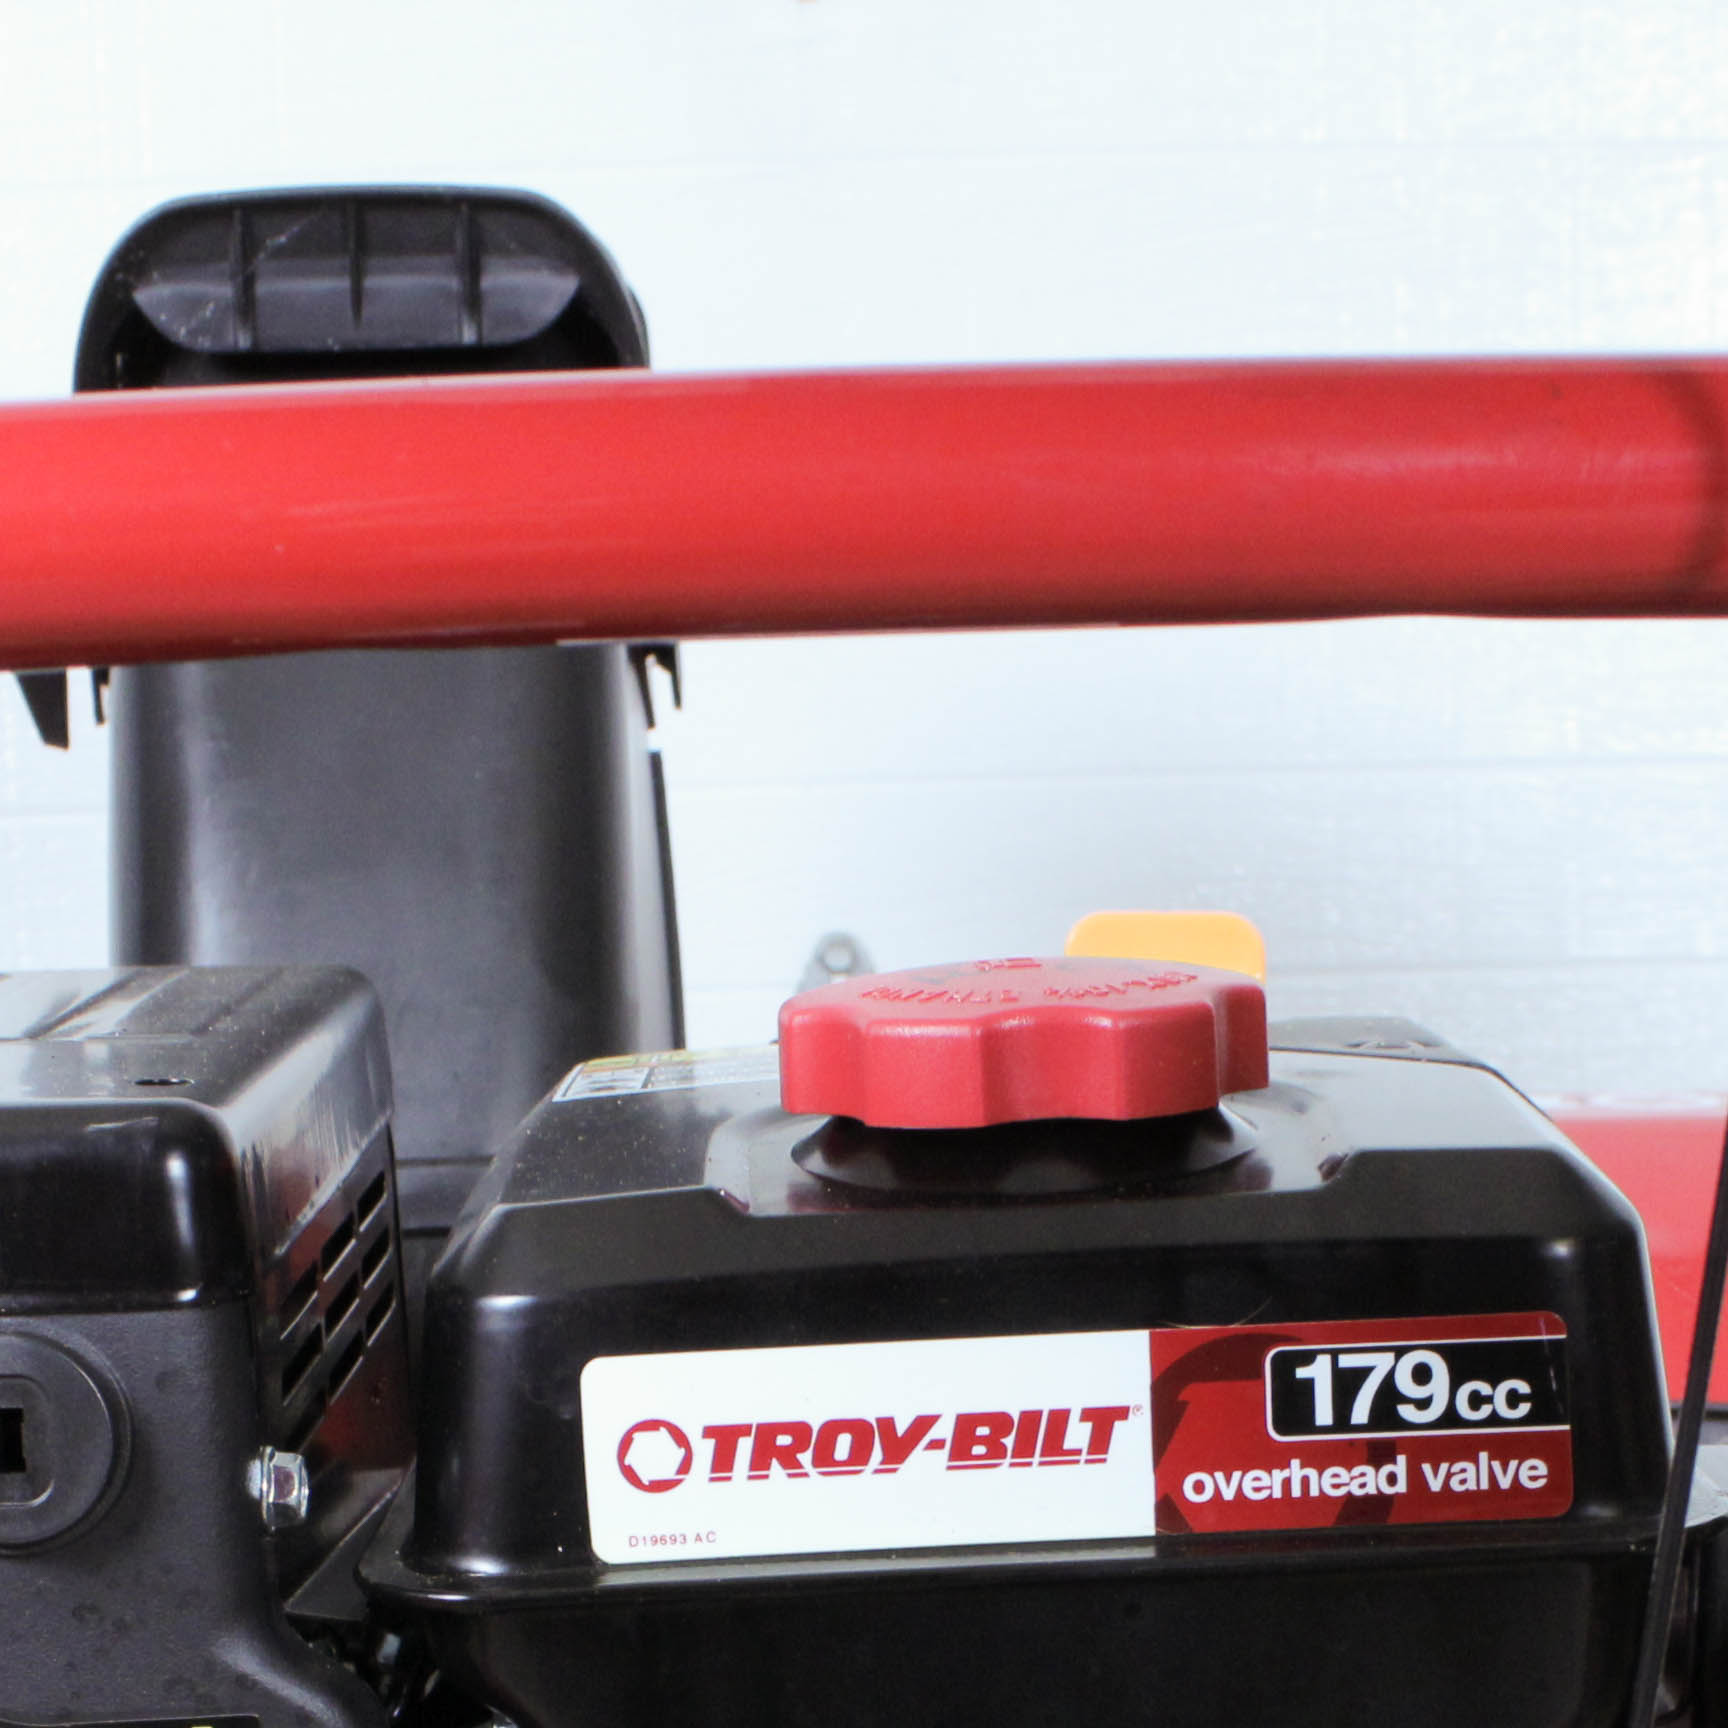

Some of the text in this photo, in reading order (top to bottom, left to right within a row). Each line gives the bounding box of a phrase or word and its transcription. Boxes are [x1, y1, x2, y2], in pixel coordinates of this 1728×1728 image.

[701, 1405, 1131, 1482] TROY-BILT
[1182, 1451, 1549, 1503] overhead valve
[694, 1530, 717, 1544] AC
